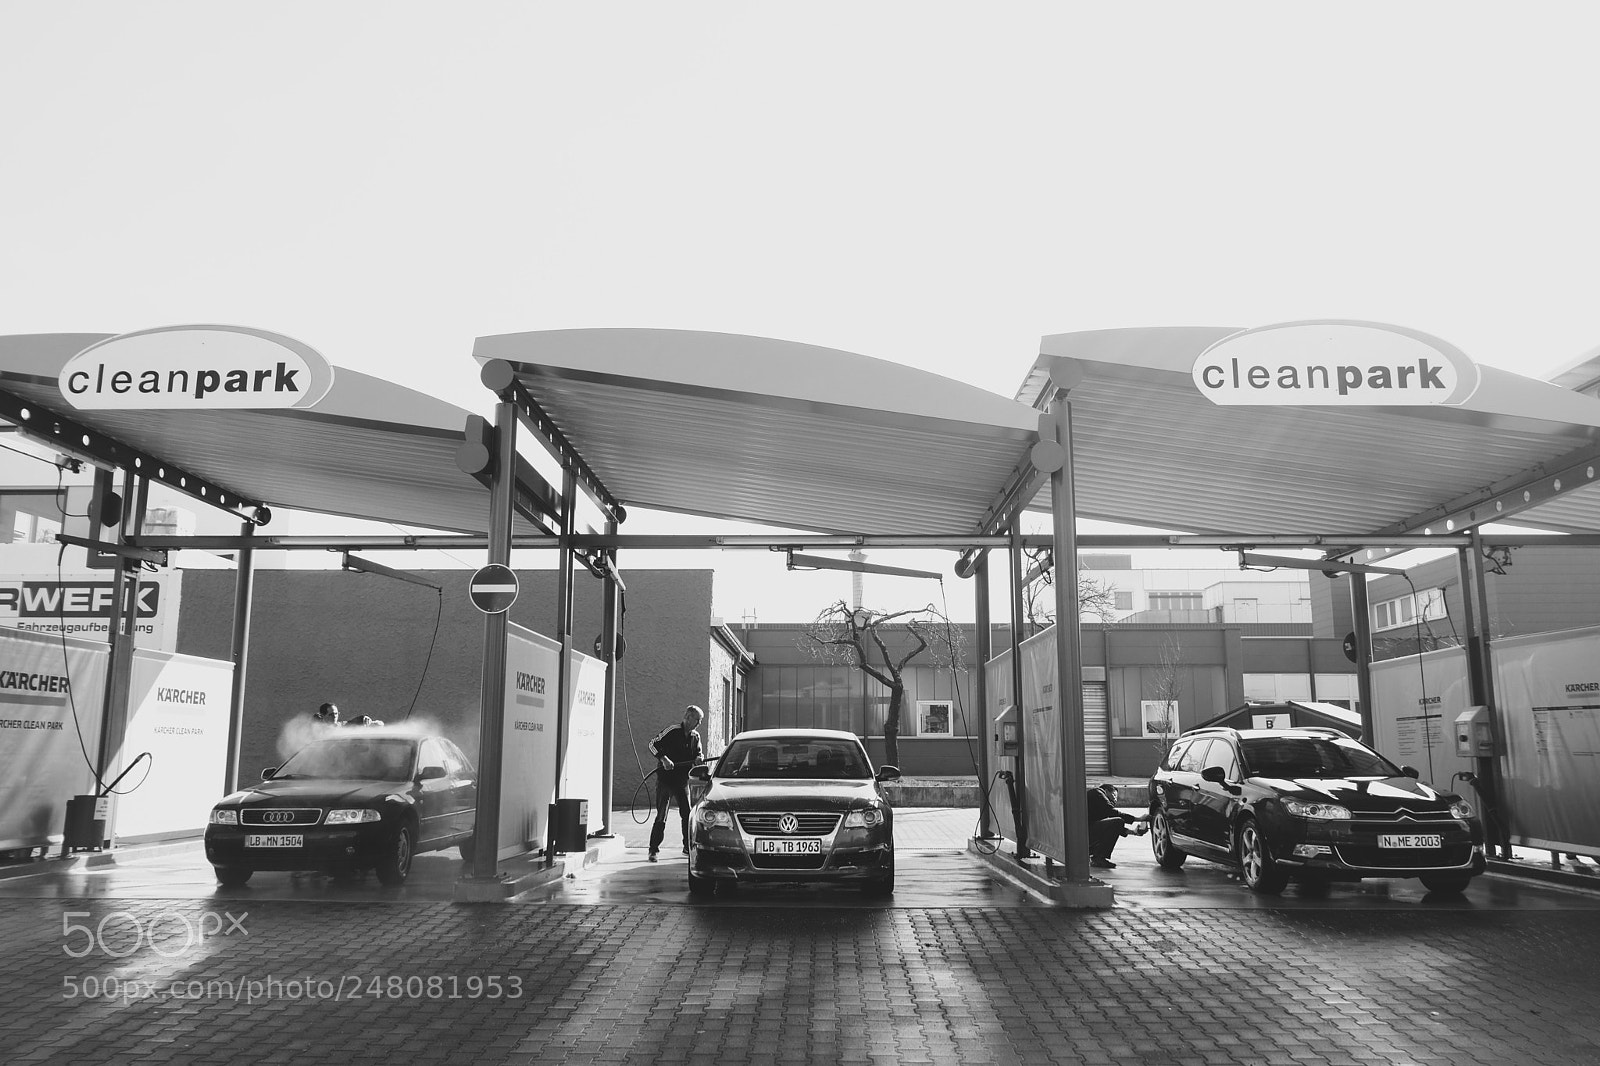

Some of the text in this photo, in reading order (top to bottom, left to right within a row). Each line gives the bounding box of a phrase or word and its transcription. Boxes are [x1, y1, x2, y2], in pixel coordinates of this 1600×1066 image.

[68, 362, 299, 399] cleanpark
[1202, 357, 1447, 395] cleanpark
[157, 687, 206, 705] KÄRCHER
[23, 720, 46, 730] CLEAN
[47, 721, 63, 730] PARK
[250, 836, 302, 847] LB MN 1504
[762, 841, 820, 853] LB TB 1963
[1384, 835, 1440, 847] N ME 2003
